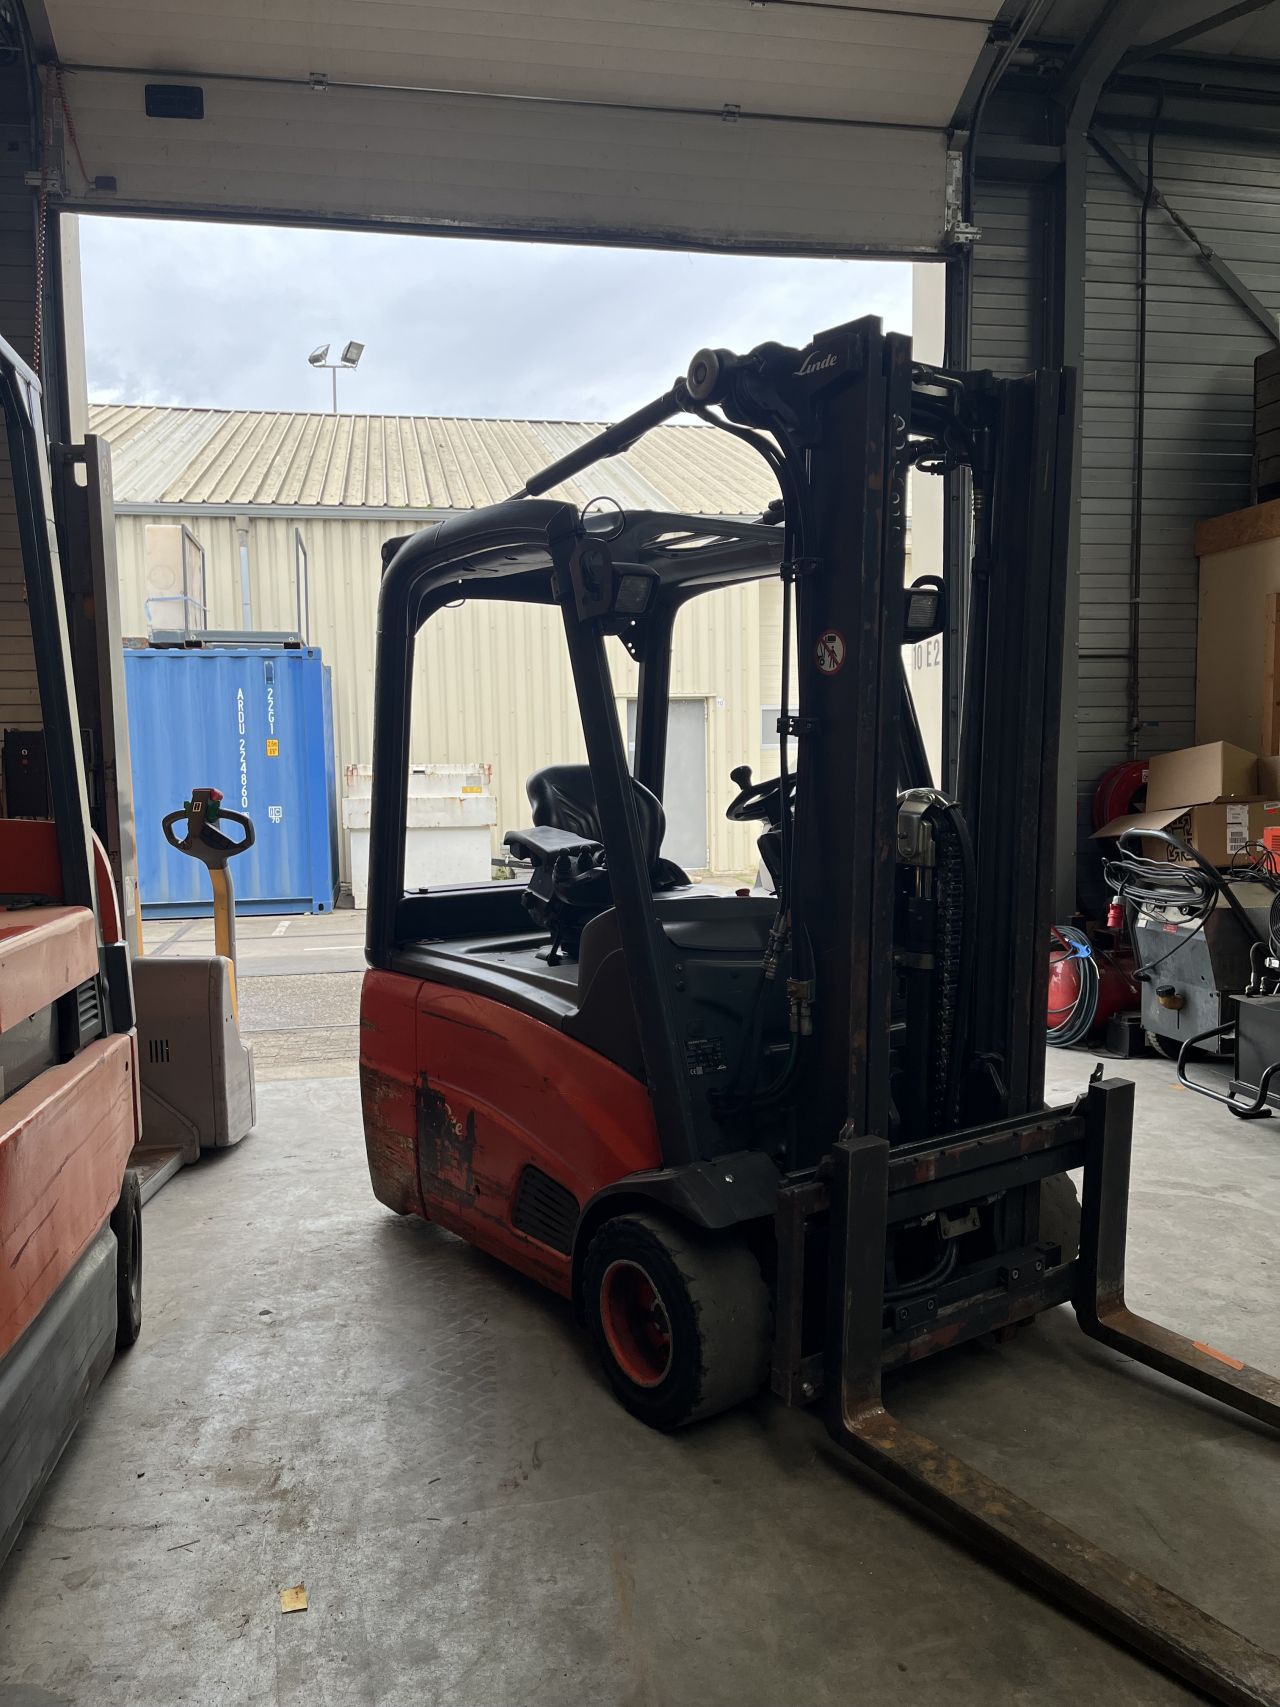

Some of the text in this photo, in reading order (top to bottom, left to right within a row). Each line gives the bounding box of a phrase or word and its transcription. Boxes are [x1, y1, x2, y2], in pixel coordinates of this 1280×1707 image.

[793, 350, 837, 376] Linde
[236, 687, 245, 735] ARDU
[267, 688, 275, 735] 22G1
[239, 739, 248, 809] 224860
